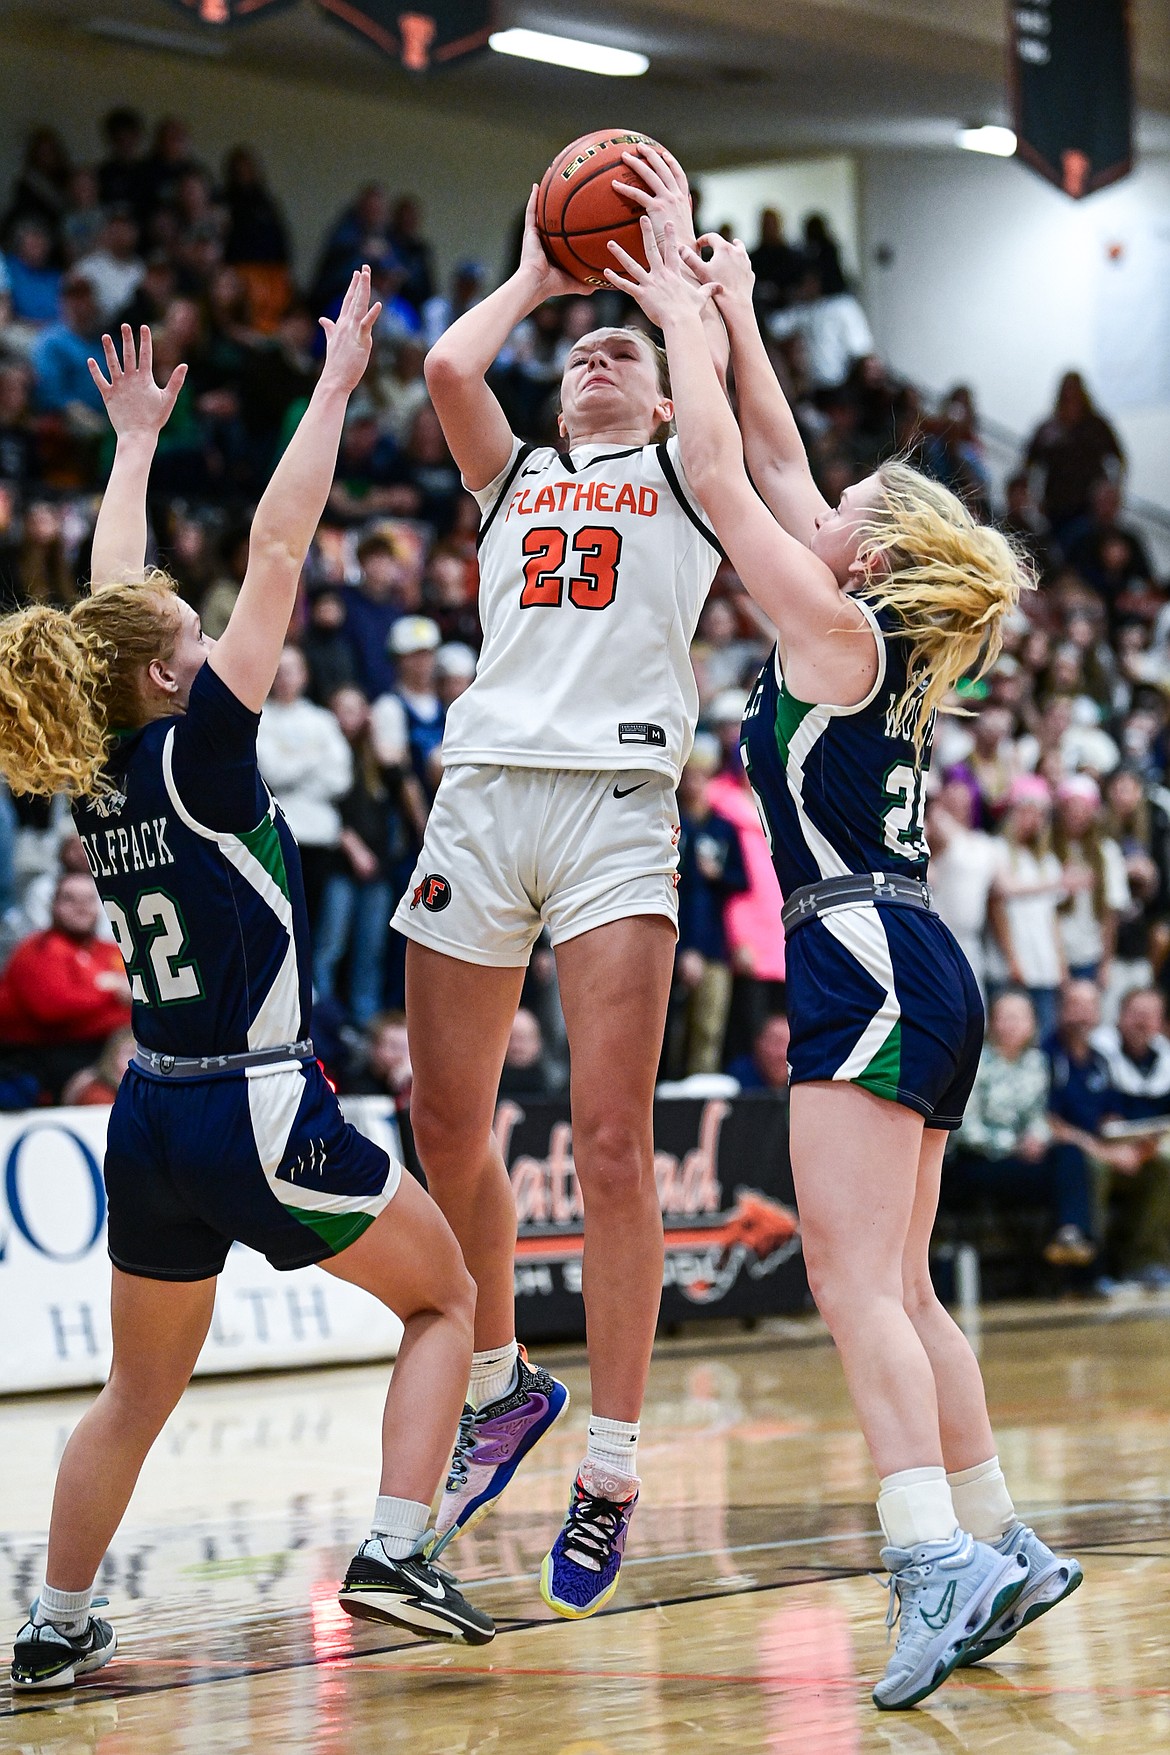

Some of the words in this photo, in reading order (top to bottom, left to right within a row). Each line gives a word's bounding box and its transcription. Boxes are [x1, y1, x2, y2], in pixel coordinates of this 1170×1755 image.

[505, 481, 659, 523] FLATHEAD
[519, 525, 623, 611] 23
[652, 729, 661, 740] M
[79, 816, 175, 878] OLFPACK
[426, 879, 446, 906] F
[48, 1283, 331, 1361] HLTH
